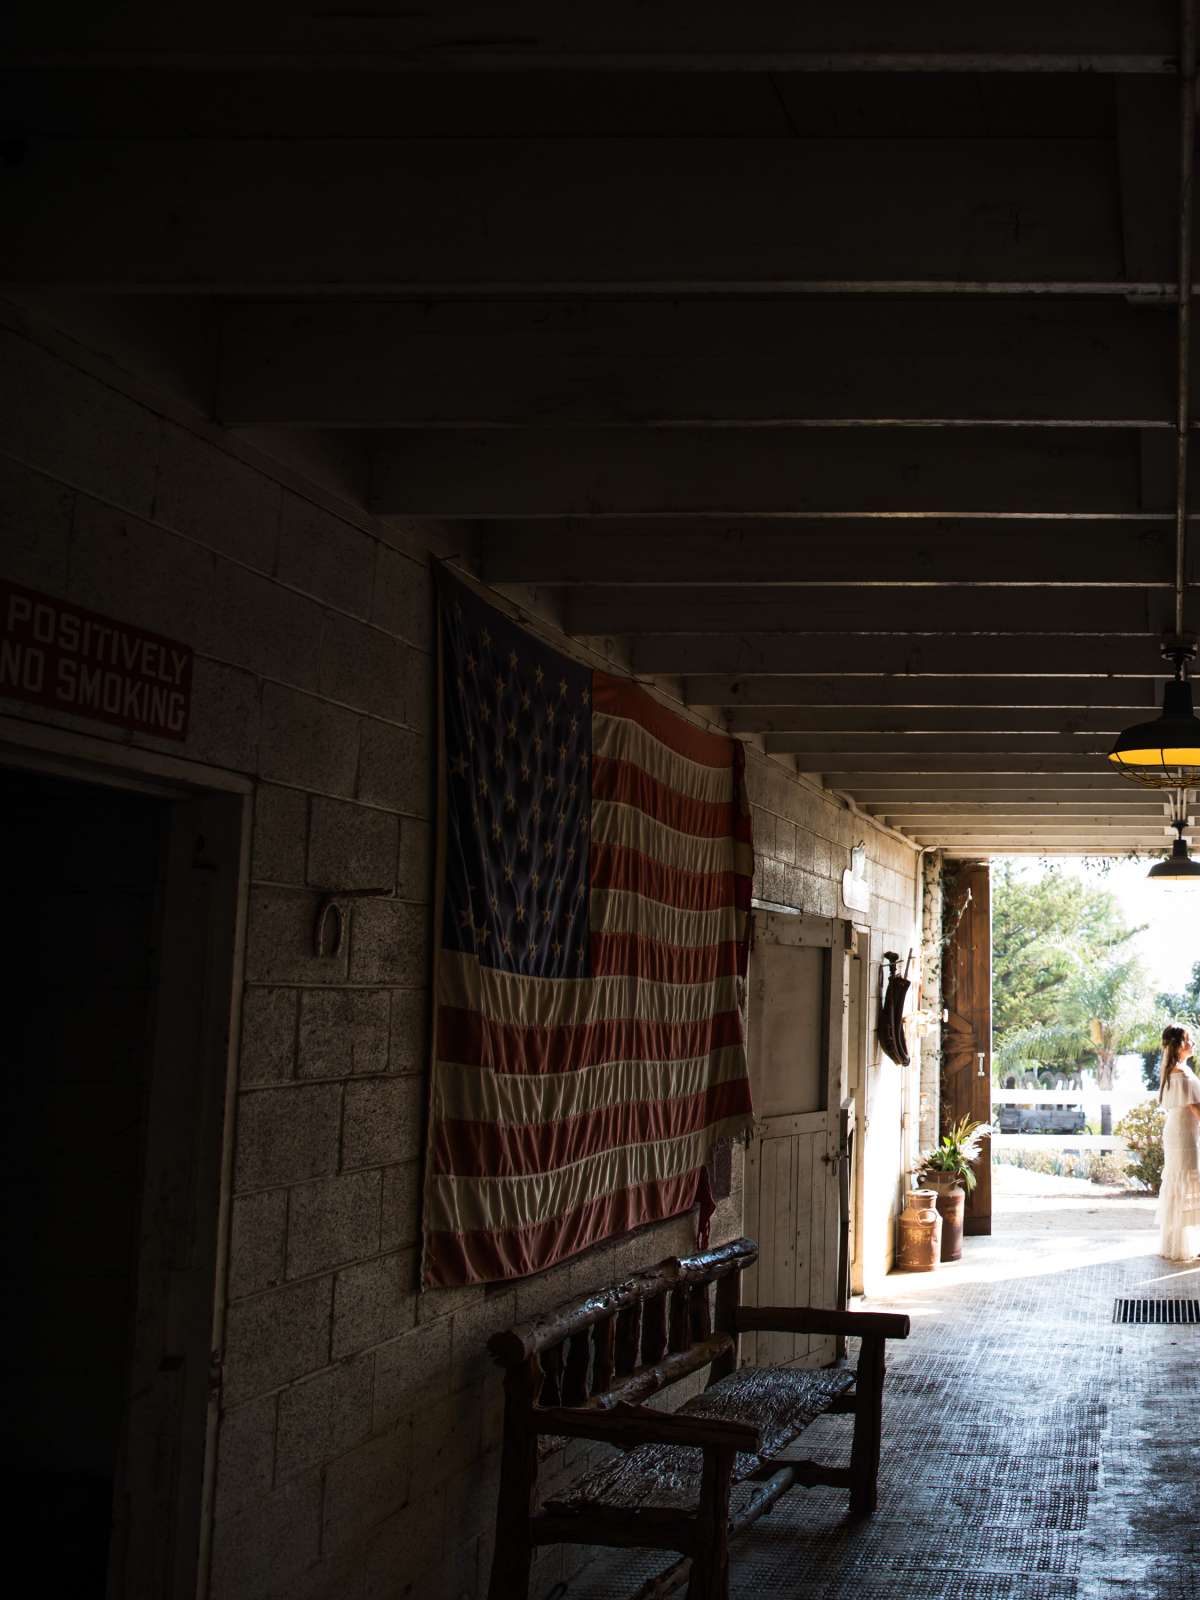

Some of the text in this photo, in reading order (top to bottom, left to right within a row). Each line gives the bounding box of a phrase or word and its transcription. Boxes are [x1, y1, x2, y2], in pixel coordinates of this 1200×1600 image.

[0, 638, 185, 733] NO SMOKING
[8, 592, 188, 686] POSITIVELY
